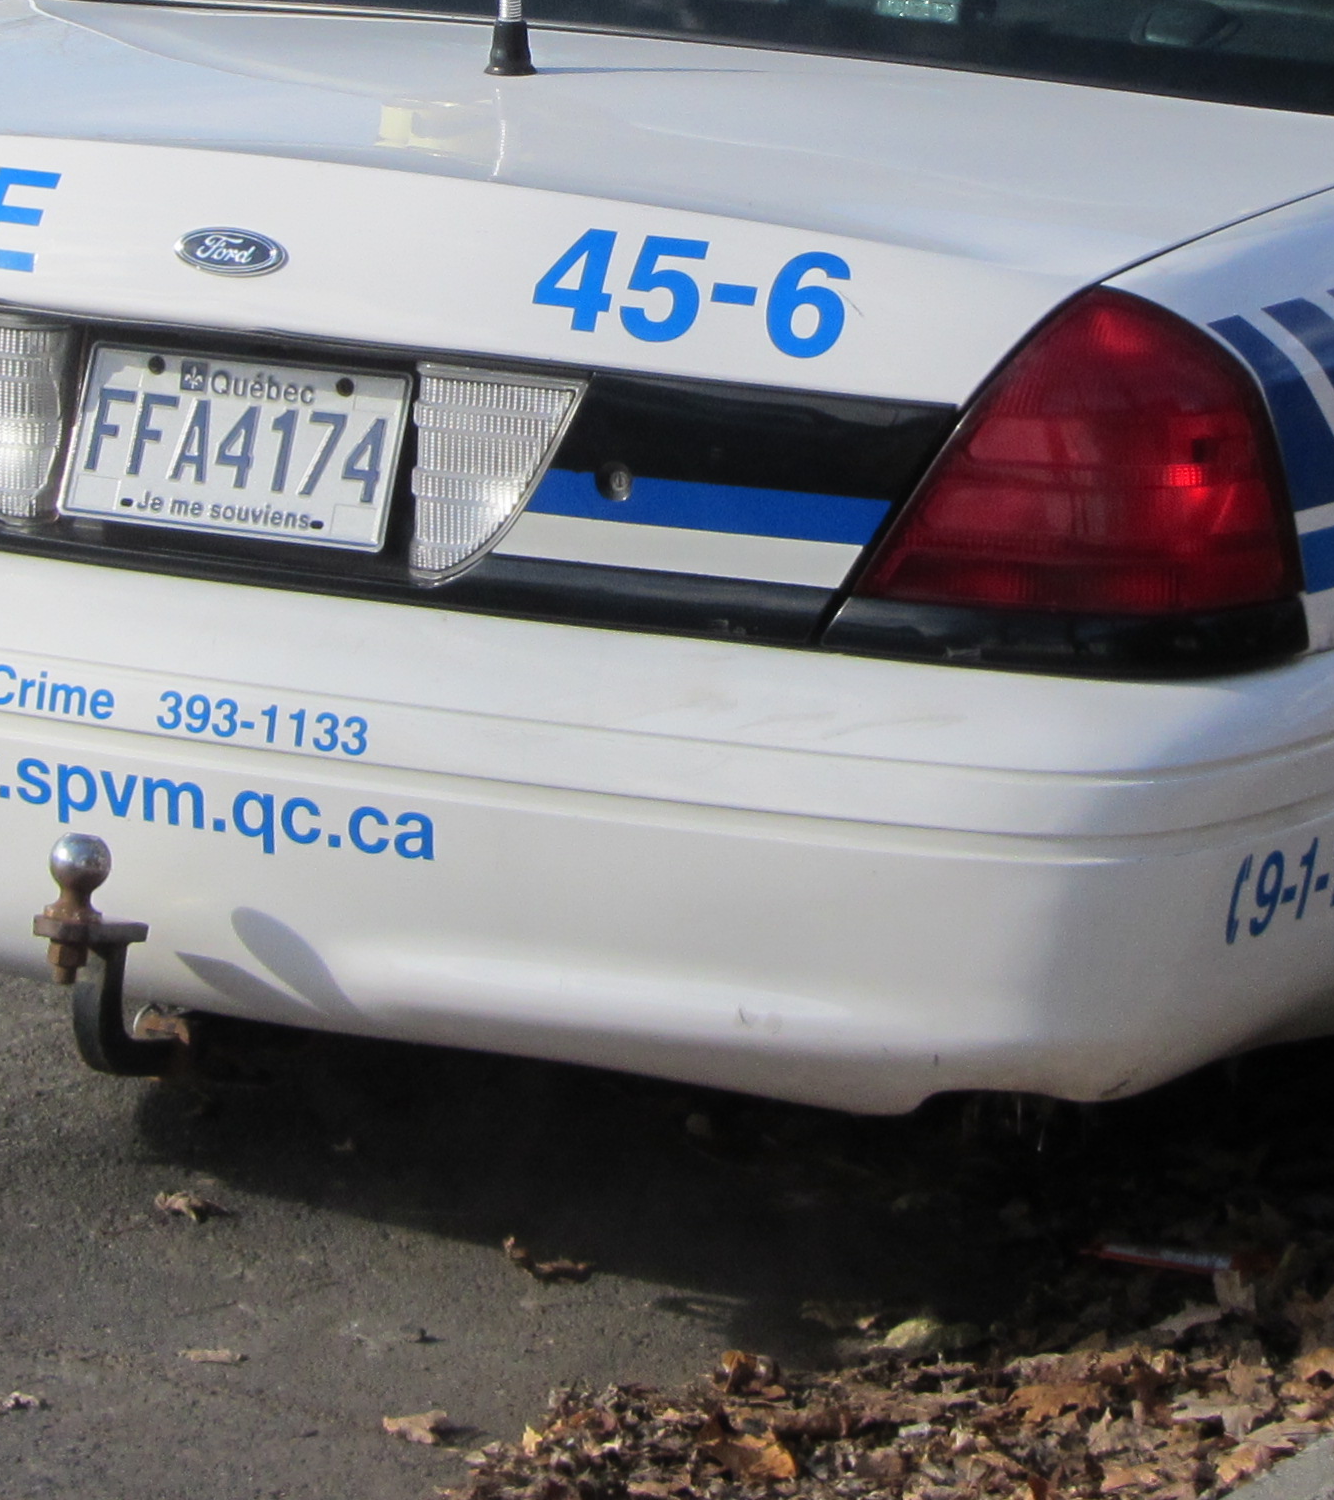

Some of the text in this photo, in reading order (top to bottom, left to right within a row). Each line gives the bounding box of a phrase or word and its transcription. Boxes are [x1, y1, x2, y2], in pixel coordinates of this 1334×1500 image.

[196, 234, 257, 264] Ford
[532, 228, 851, 359] 45-6
[212, 370, 316, 406] Québec
[83, 387, 387, 504] FFA4174
[137, 491, 310, 530] Je me souviens
[156, 690, 369, 757] 393-1133
